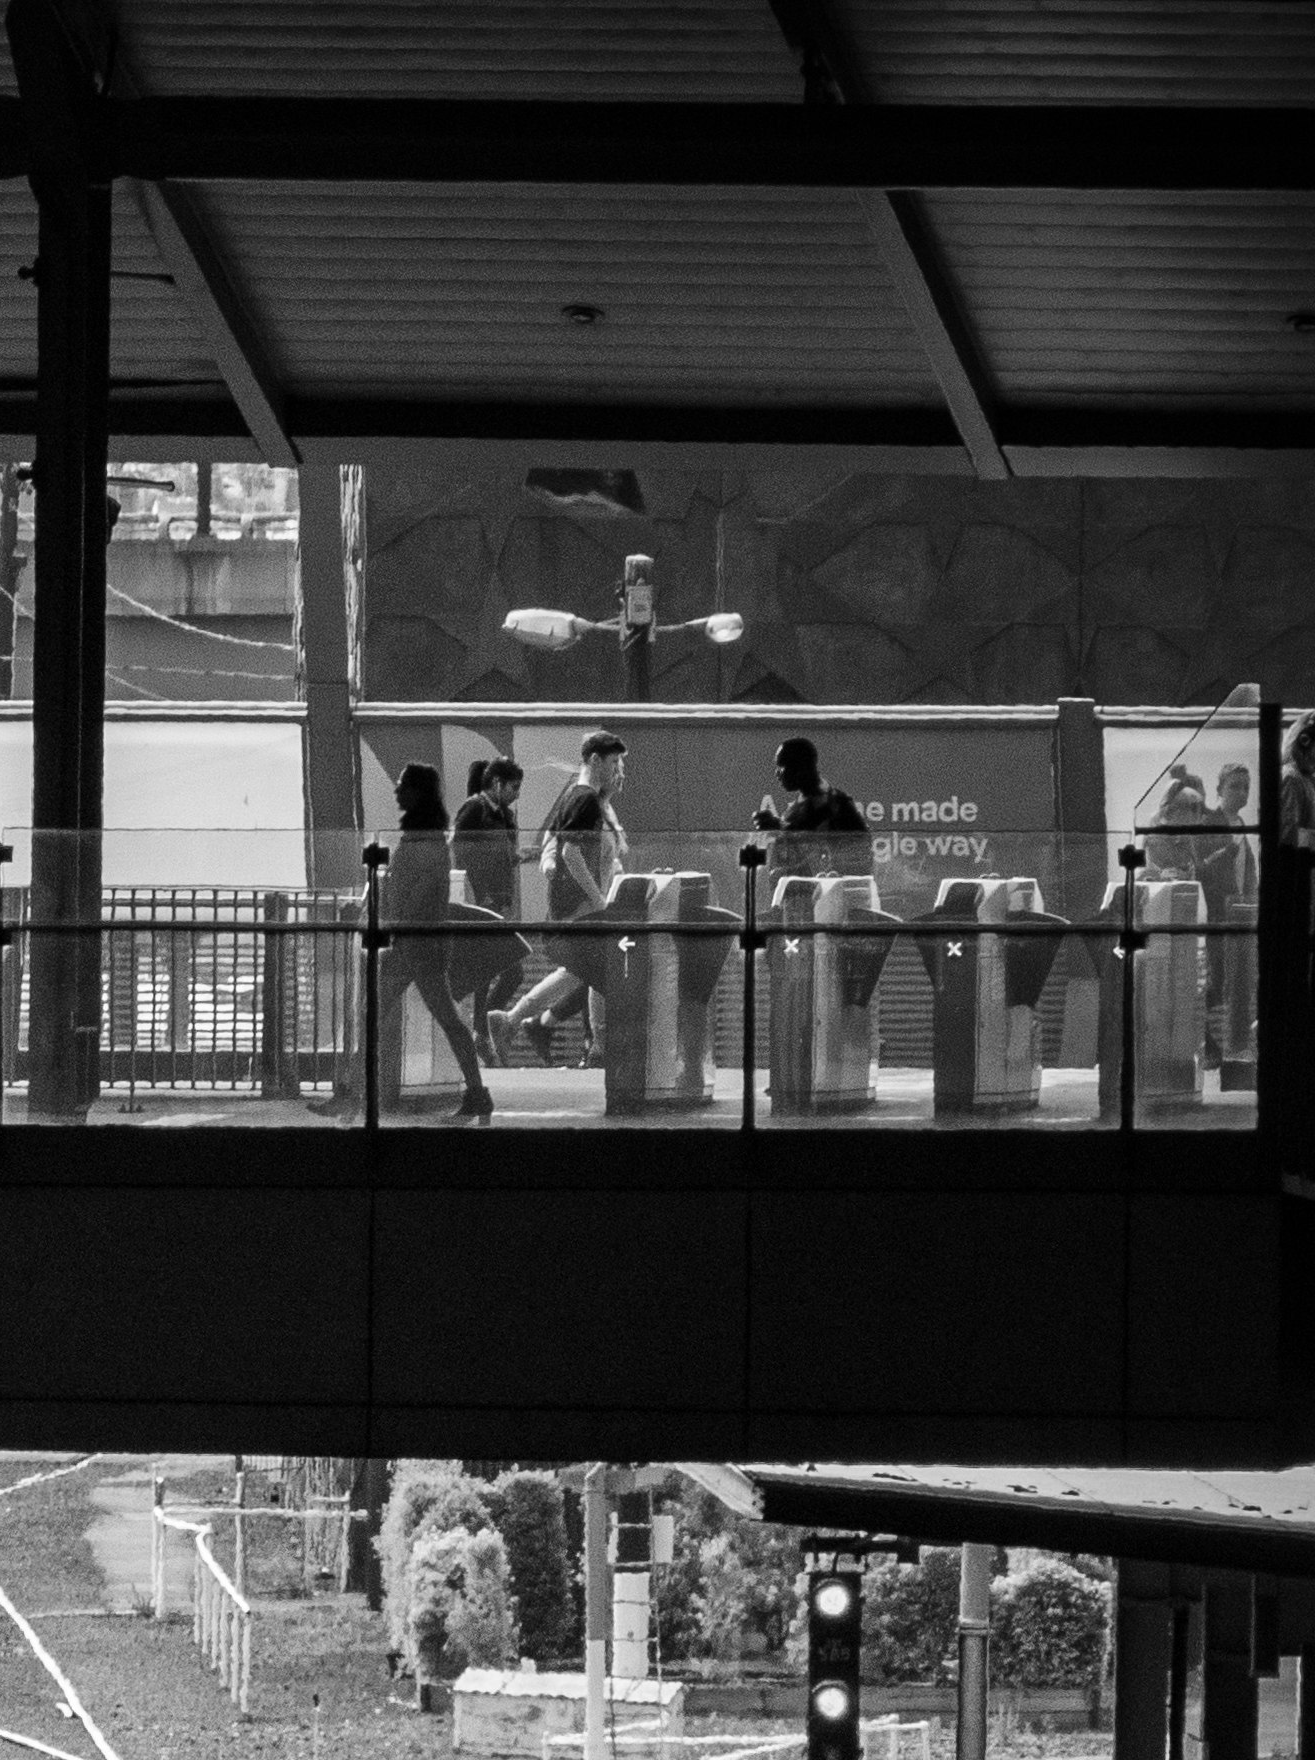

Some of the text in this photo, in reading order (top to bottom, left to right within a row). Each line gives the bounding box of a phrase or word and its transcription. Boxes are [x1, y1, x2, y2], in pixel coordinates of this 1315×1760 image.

[892, 795, 978, 822] made
[872, 831, 988, 863] gle way
